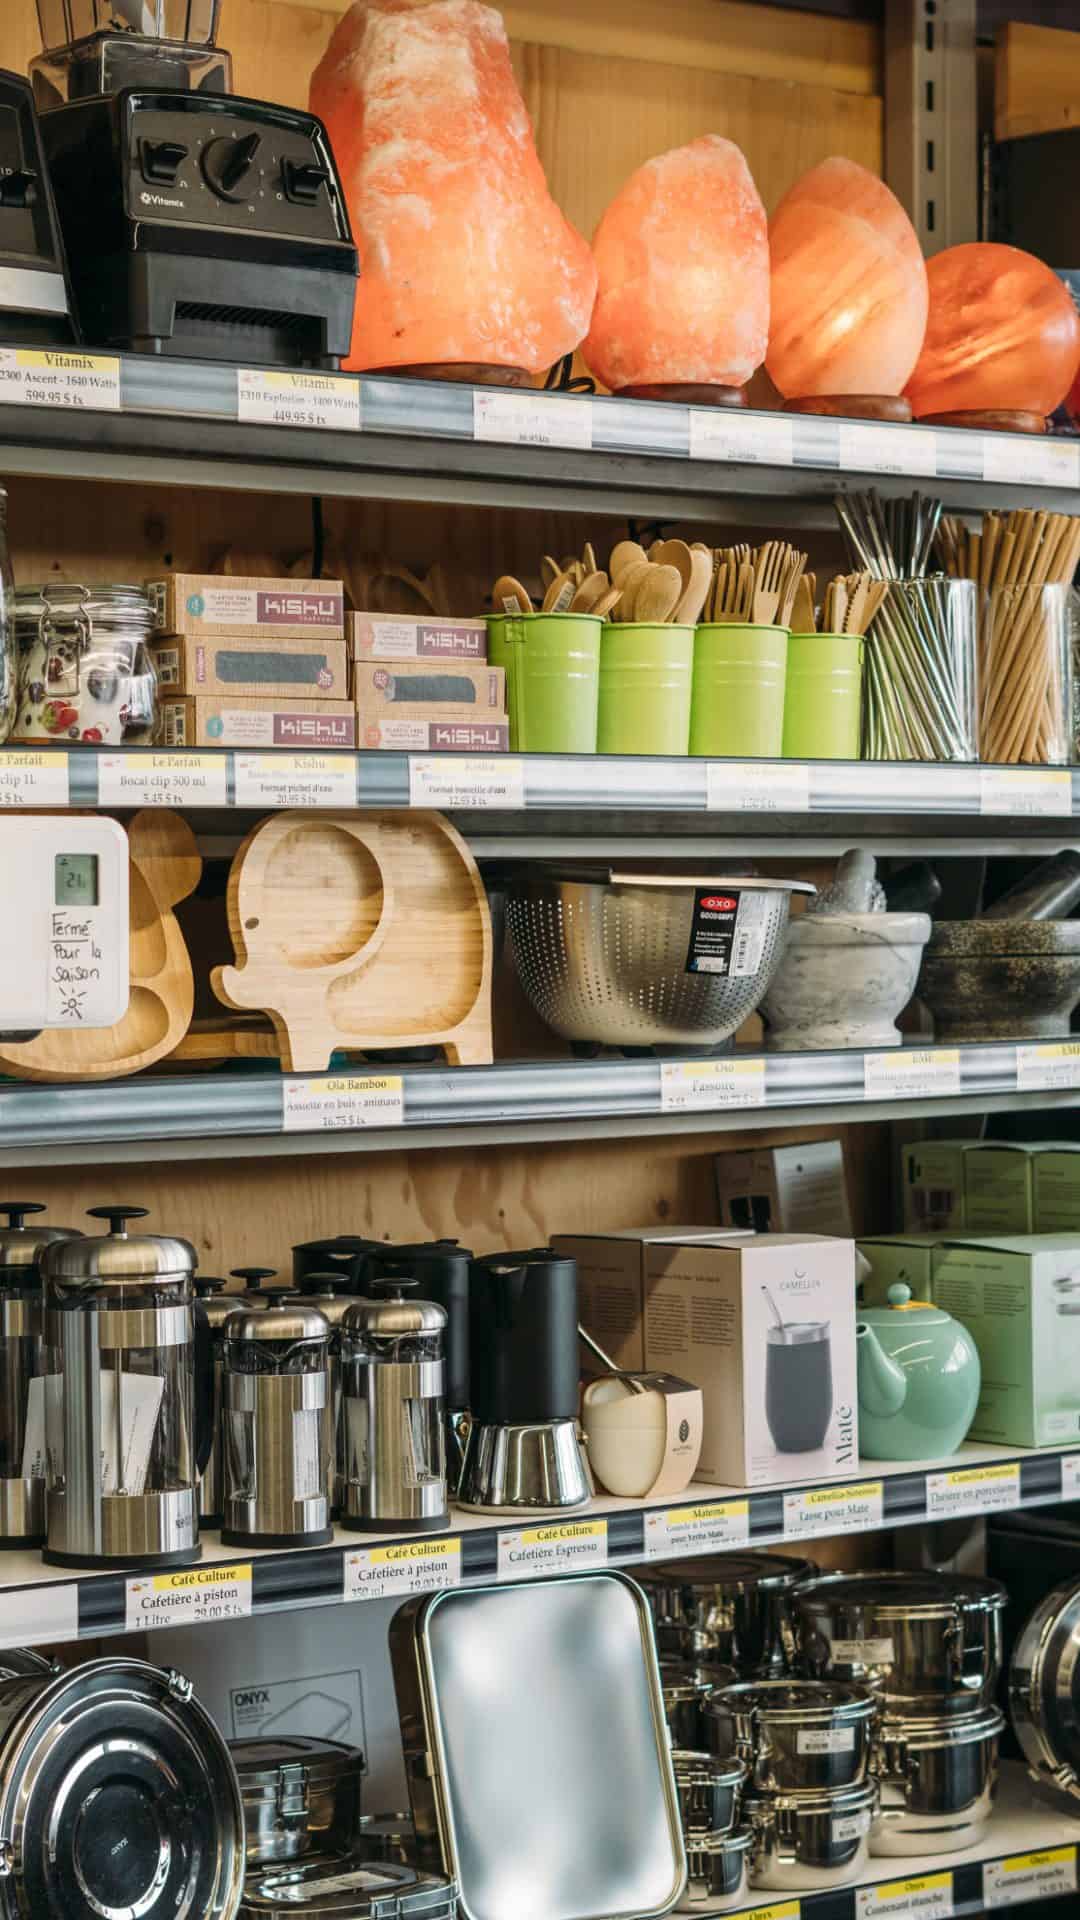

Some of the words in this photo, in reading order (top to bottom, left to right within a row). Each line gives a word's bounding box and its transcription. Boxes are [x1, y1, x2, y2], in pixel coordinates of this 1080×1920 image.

[151, 195, 185, 208] Vitamix
[44, 353, 95, 369] Vitamix
[24, 371, 58, 385] Ascent
[66, 375, 88, 386] 1640
[290, 376, 336, 390] Vitamix
[25, 390, 62, 402] 599.95
[7, 754, 43, 767] Parfait
[167, 756, 202, 768] Parfait
[294, 756, 326, 769] Kishu
[120, 774, 149, 787] Bocal
[150, 775, 171, 789] clip
[707, 899, 730, 908] OXO
[51, 911, 93, 937] Fermé
[91, 941, 102, 960] la
[327, 1079, 345, 1091] Ola
[348, 1078, 388, 1090] Bamboo
[835, 1405, 853, 1465] Maté
[537, 1529, 558, 1541] Café
[560, 1525, 593, 1537] Culture
[386, 1547, 408, 1560] Café
[410, 1543, 446, 1557] Culture
[509, 1546, 553, 1562] Cafetière
[171, 1574, 195, 1587] Café
[197, 1569, 237, 1583] Culture
[358, 1566, 405, 1582] Cafetière
[407, 1564, 413, 1575] à
[416, 1561, 448, 1577] piston
[140, 1591, 192, 1609] Cafetière
[194, 1591, 202, 1602] à
[203, 1588, 238, 1605] piston
[144, 1613, 171, 1627] Litre
[234, 1689, 271, 1707] ONYX
